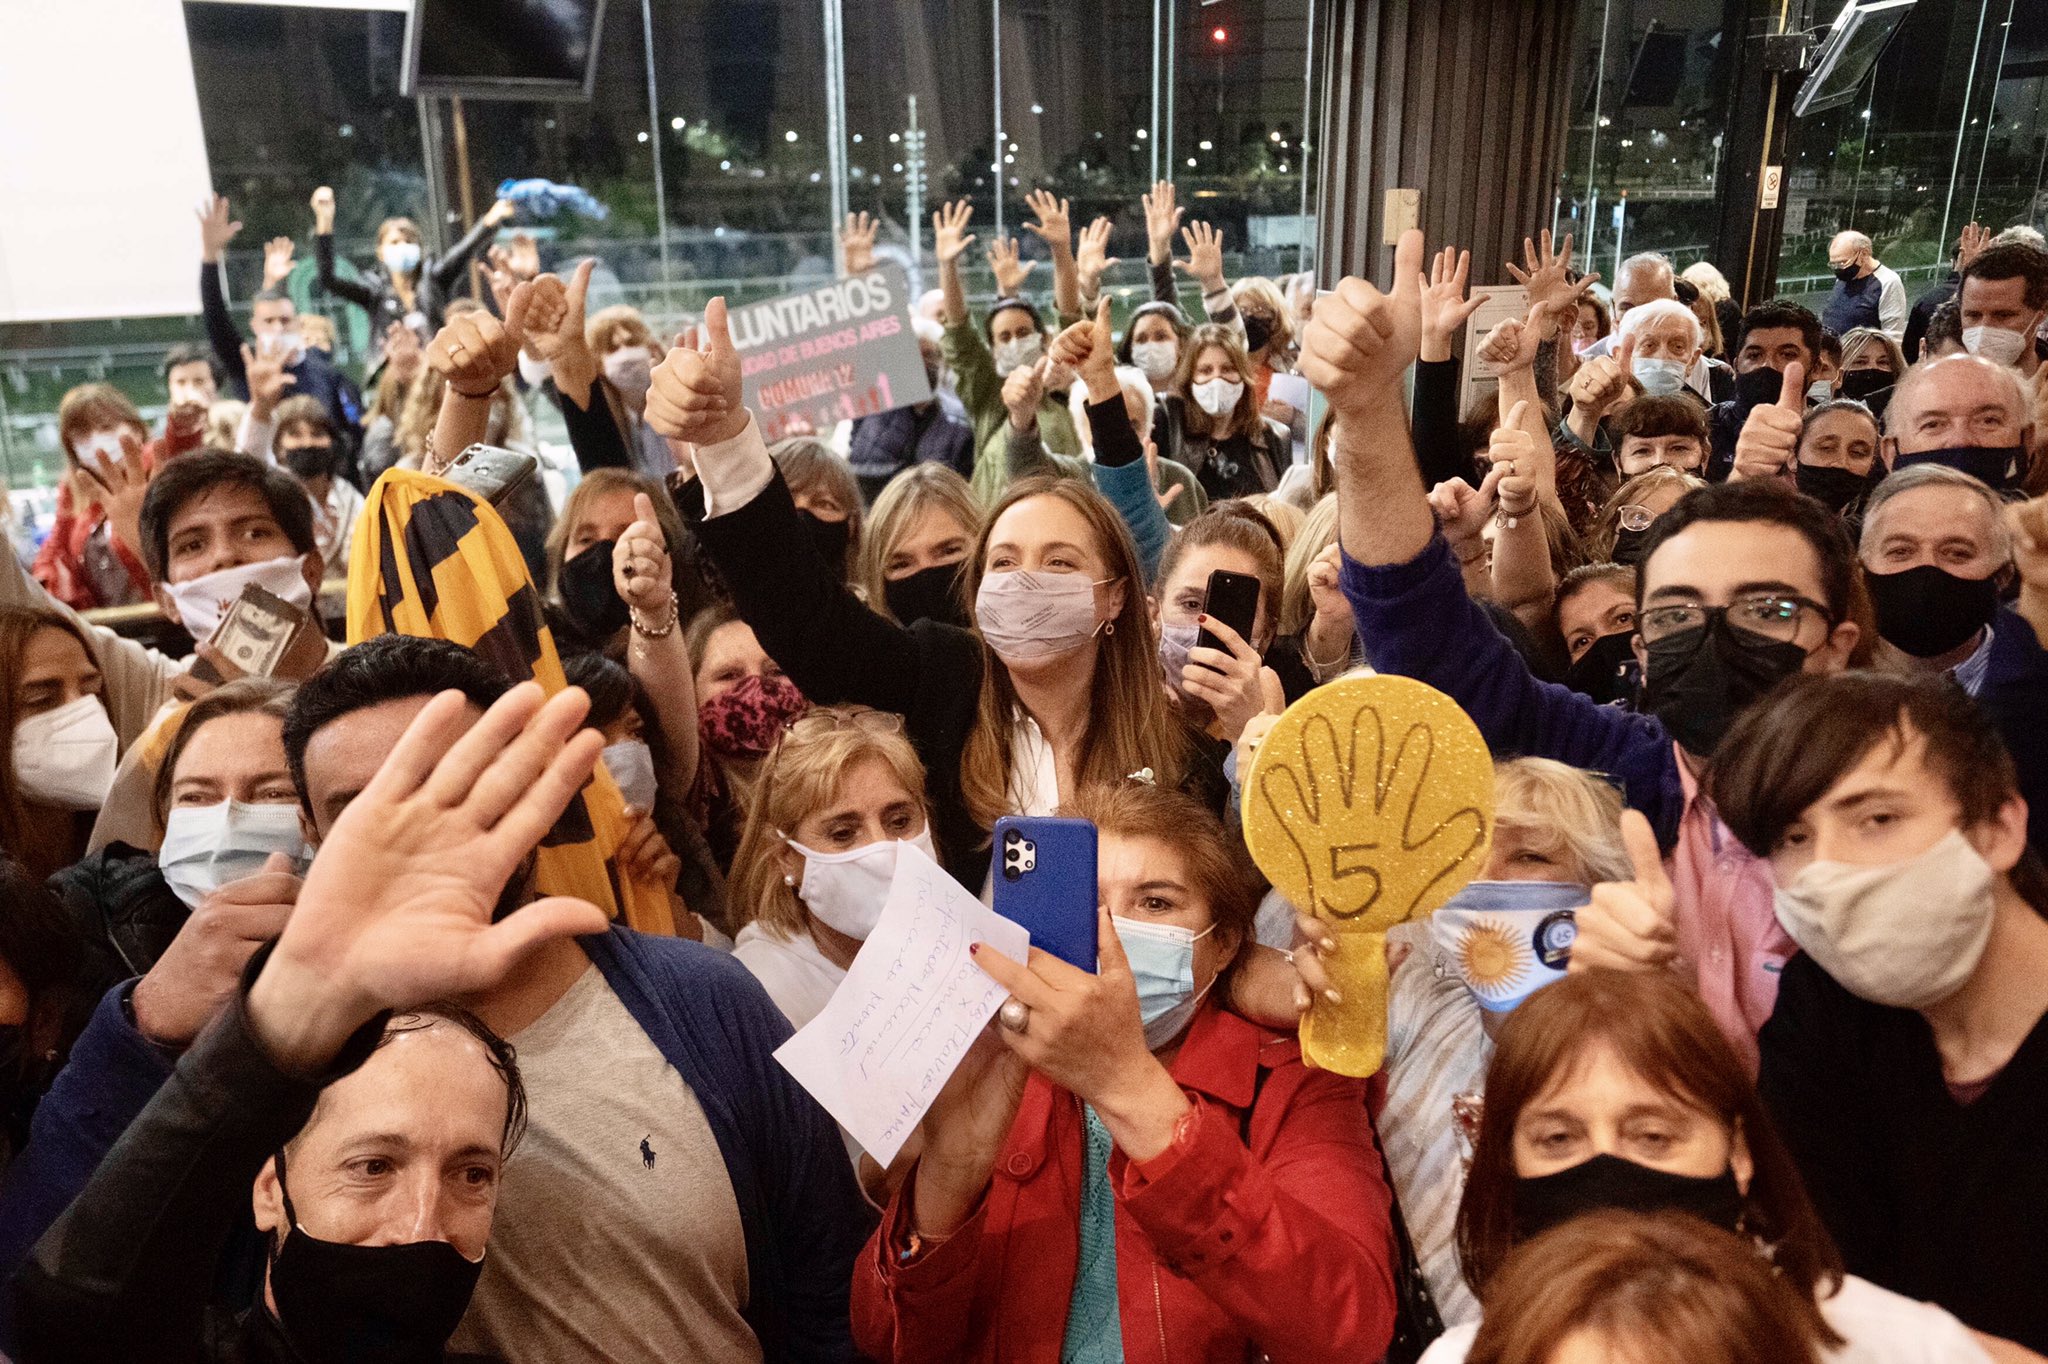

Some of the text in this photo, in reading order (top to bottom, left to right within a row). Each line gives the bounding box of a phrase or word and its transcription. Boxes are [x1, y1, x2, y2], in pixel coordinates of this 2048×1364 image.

[698, 272, 892, 352] LUNTARIOS
[799, 327, 858, 359] BUENOS
[859, 314, 901, 343] AIRES
[1320, 842, 1382, 920] 5
